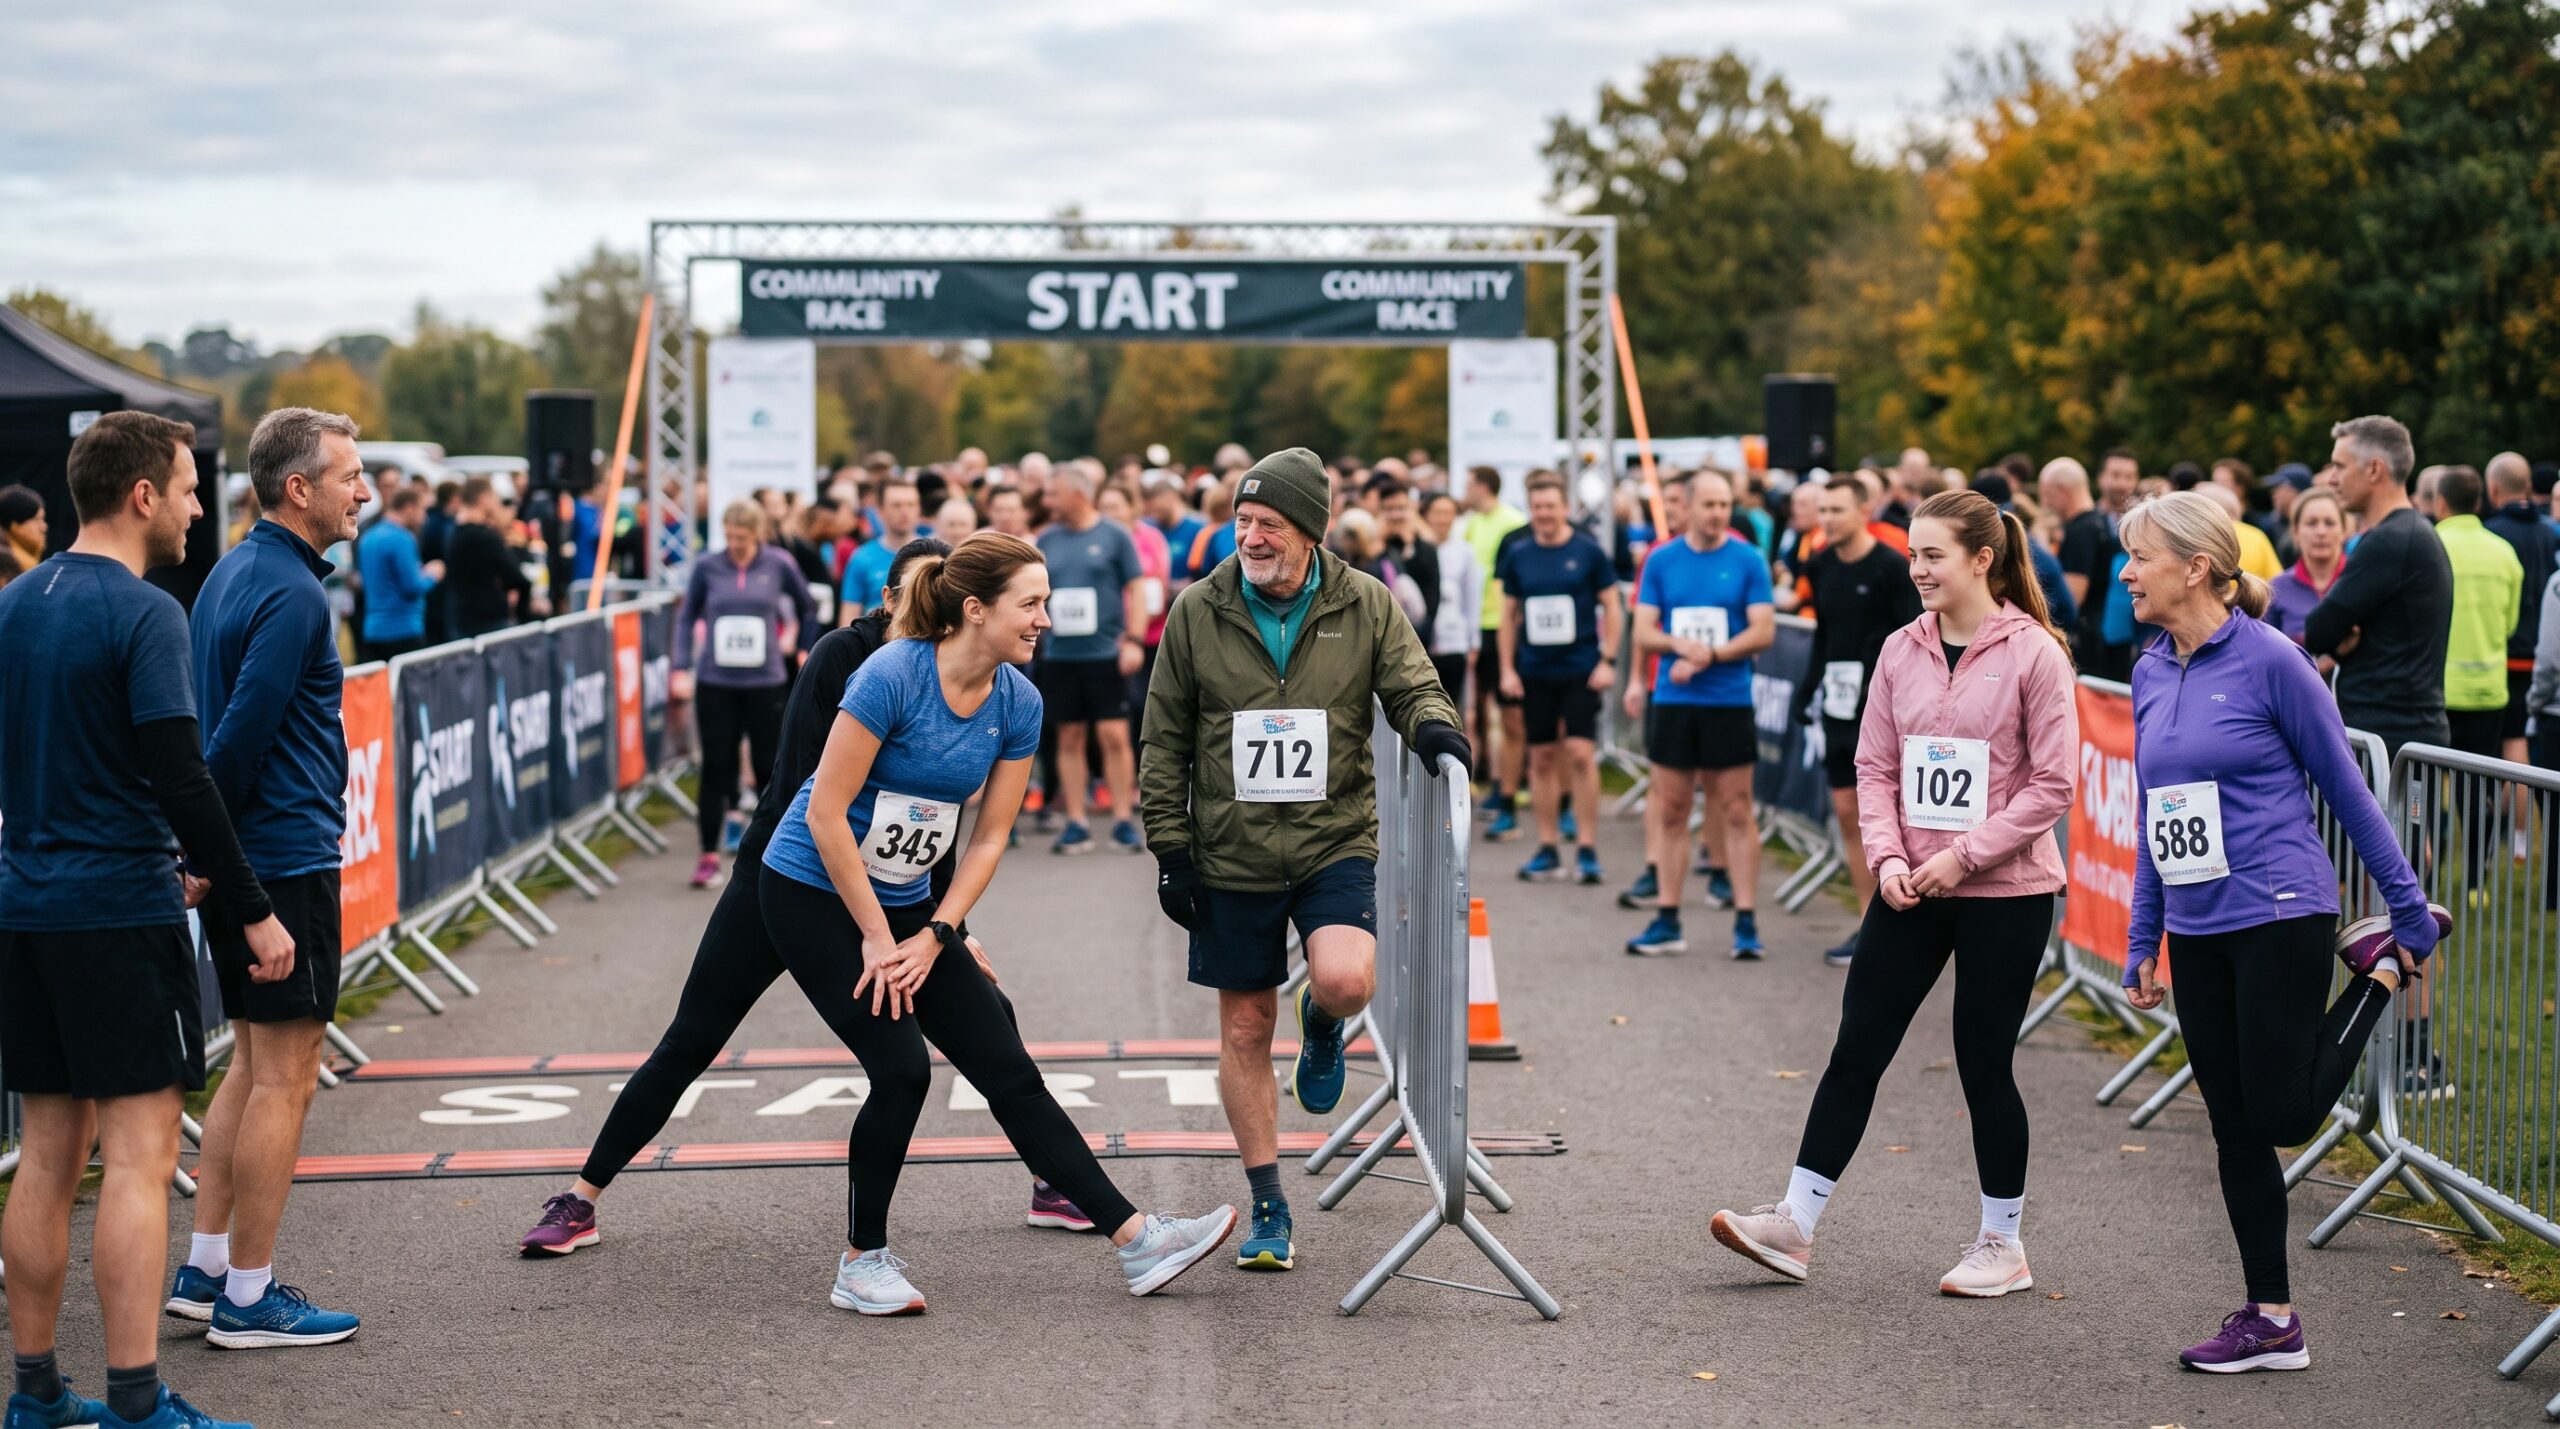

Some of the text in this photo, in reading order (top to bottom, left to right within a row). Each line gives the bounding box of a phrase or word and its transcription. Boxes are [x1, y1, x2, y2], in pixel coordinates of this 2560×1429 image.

[749, 268, 942, 299] COMMUNITY
[1026, 270, 1239, 331] START
[1321, 269, 1514, 300] COMMUNITY
[804, 300, 888, 331] RACE
[1376, 301, 1458, 331] RACE
[429, 717, 475, 798] START
[1246, 738, 1313, 779] 712
[1916, 765, 1973, 808] 102
[875, 822, 942, 867] 345
[2154, 815, 2210, 862] 588
